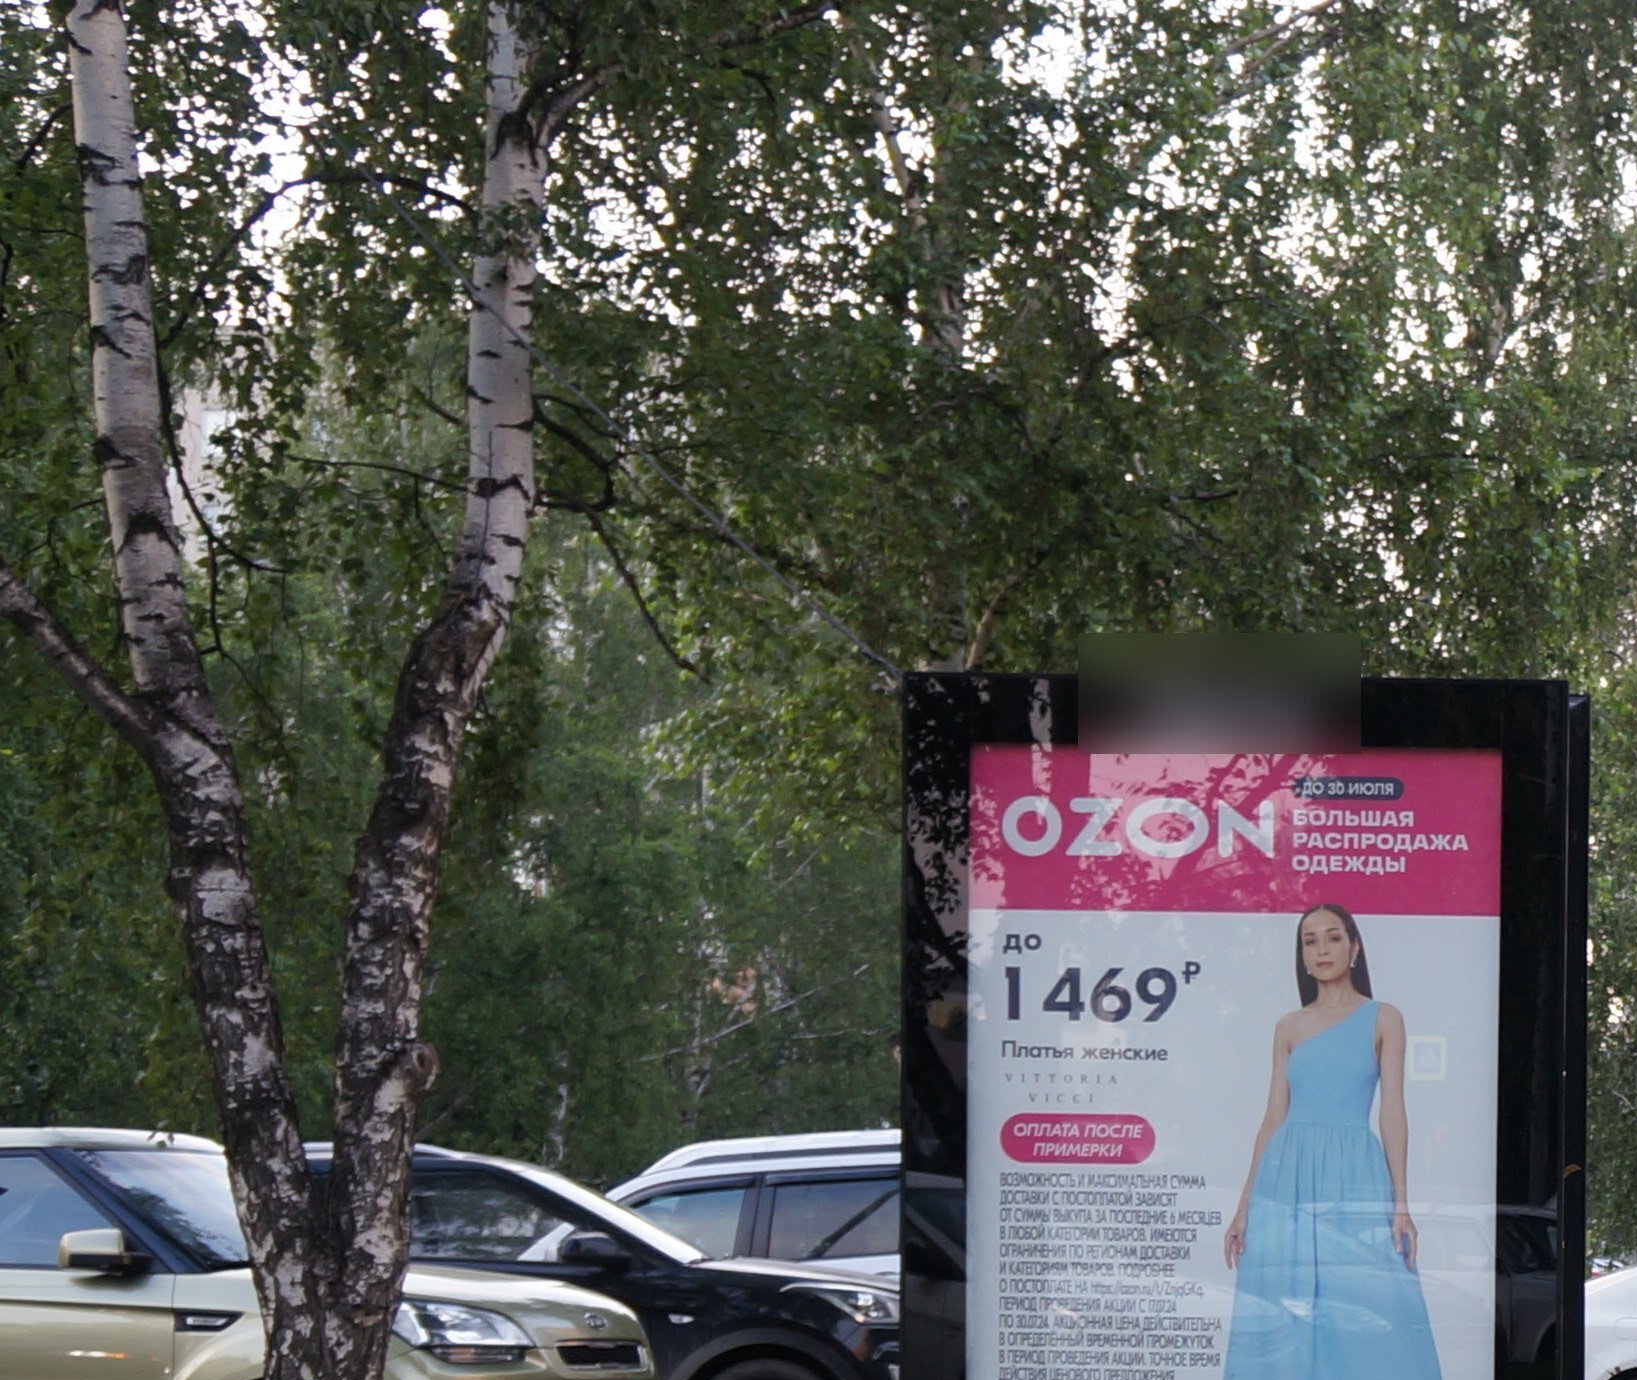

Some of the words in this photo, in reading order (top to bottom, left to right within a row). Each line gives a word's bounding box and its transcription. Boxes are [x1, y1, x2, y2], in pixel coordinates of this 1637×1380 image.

[1301, 781, 1324, 797] ДО
[1327, 781, 1344, 796] 30
[1347, 782, 1395, 797] ИЮЛЯ
[1002, 796, 1274, 859] OZON
[1293, 809, 1415, 828] БОЛЬШАЯ
[1292, 832, 1469, 852] РАСПРОДАЖА
[1292, 854, 1406, 874] ОДЕЖДЫ
[1002, 934, 1042, 955] до
[1001, 1040, 1074, 1059] Платья
[1081, 1045, 1168, 1061] женские
[1004, 1073, 1119, 1084] VITTORIA
[1013, 1123, 1080, 1138] ОПЛАТА
[1083, 1124, 1144, 1139] ПОСЛЕ
[1032, 1142, 1123, 1158] ПРИМЕРКИ
[1000, 1172, 1075, 1187] ВОЗМОЖНОСТЬ
[1078, 1174, 1085, 1187] И
[1087, 1173, 1168, 1188] МАКСИМАЛЬНАЯ
[1170, 1175, 1206, 1189] СУММА
[1000, 1190, 1049, 1205] ДОСТАВКИ
[1052, 1191, 1059, 1205] С
[1062, 1190, 1132, 1206] ПОСТОПЛАТОЙ
[1135, 1192, 1178, 1206] ЗАВИСЯТ
[1000, 1208, 1012, 1222] ОТ
[1014, 1208, 1049, 1222] СУММЫ
[1053, 1208, 1092, 1223] ВЫКУПА
[1095, 1209, 1107, 1224] ЗА
[1110, 1209, 1168, 1225] ПОСЛЕДНИЕ
[1178, 1211, 1222, 1227] МЕСЯЦЕВ
[1000, 1225, 1006, 1240] В
[1008, 1223, 1045, 1240] ЛЮБОЙ
[1150, 1228, 1197, 1243] ИМЕЮТСЯ
[1000, 1243, 1066, 1258] ОГРАНИЧЕНИЯ
[1069, 1244, 1083, 1258] ПО
[1087, 1244, 1137, 1259] РЕГИОНАМ
[1139, 1245, 1190, 1261] ДОСТАВКИ
[1000, 1261, 1006, 1275] И
[1118, 1262, 1175, 1278] ПОДРОБНЕЕ
[1000, 1278, 1007, 1293] О
[1010, 1278, 1072, 1293] ПОСТОПЛАТЕ
[1075, 1280, 1088, 1293] НА
[1000, 1296, 1037, 1312] ПЕРИОД
[1040, 1297, 1101, 1312] ПРОВЕДЕНИЯ
[1103, 1298, 1136, 1314] АКЦИИ
[1138, 1299, 1146, 1313] С
[1000, 1313, 1014, 1328] ПО
[1053, 1314, 1113, 1331] АКЦИОННАЯ
[1115, 1316, 1140, 1331] ЦЕНА
[1142, 1315, 1222, 1332] ДЕЙСТВИТЕЛЬНА
[999, 1331, 1005, 1346] В
[1087, 1331, 1144, 1348] ВРЕМЕННОЙ
[1147, 1334, 1214, 1349] ПРОМЕЖУТОК
[999, 1349, 1005, 1364] В
[1008, 1349, 1045, 1365] ПЕРИОД
[1048, 1350, 1109, 1365] ПРОВЕДЕНИЯ
[1149, 1352, 1187, 1367] ТОЧНОЕ
[1189, 1352, 1220, 1367] ВРЕМЯ
